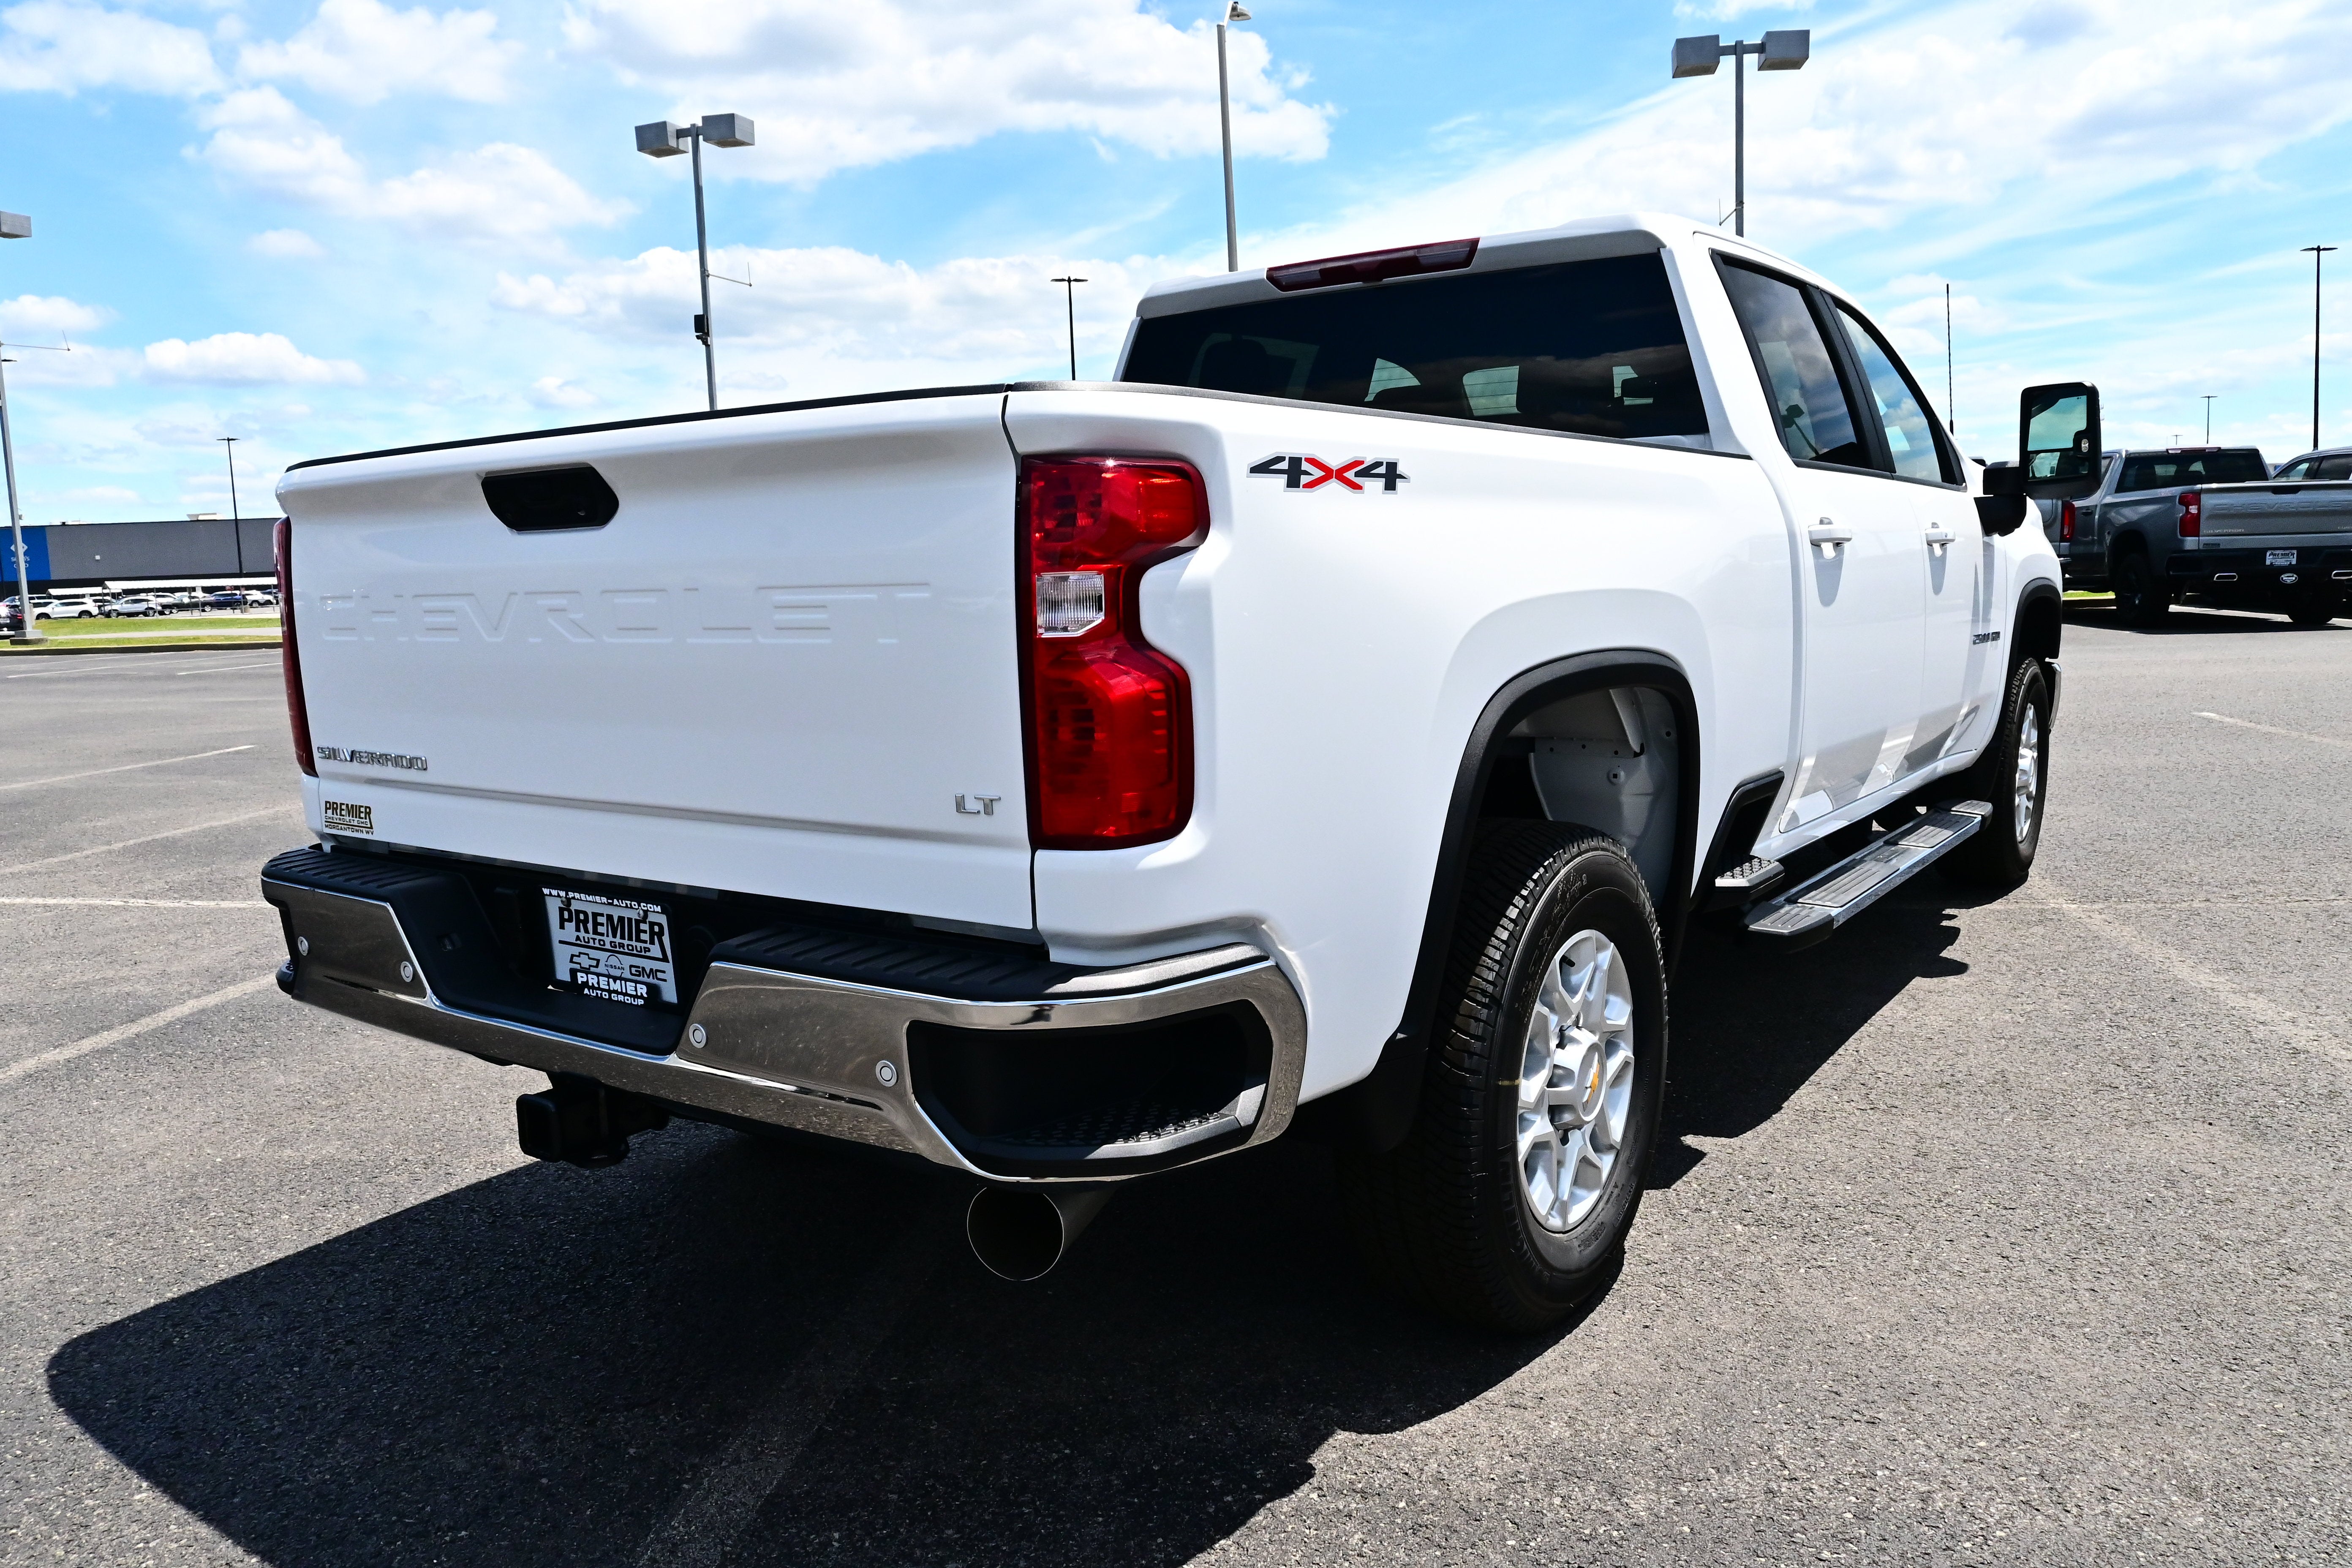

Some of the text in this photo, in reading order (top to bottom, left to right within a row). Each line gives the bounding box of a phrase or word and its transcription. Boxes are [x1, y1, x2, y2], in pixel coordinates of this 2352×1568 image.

[320, 583, 929, 641] CHEVROLET
[317, 746, 427, 770] SILVERADO
[325, 800, 372, 820] PREMIER
[955, 793, 1001, 815] LT
[324, 815, 355, 824] CHEVROLET
[324, 824, 364, 834] MORGANTOWN
[542, 887, 662, 912] WWW.PREMIER-AUTO.COM
[558, 906, 666, 947] PREMIER
[575, 935, 651, 954] AUTO GROUP
[629, 964, 667, 982] GMC
[577, 972, 648, 997] PREMIER
[584, 988, 644, 1005] AUTO GROUP
